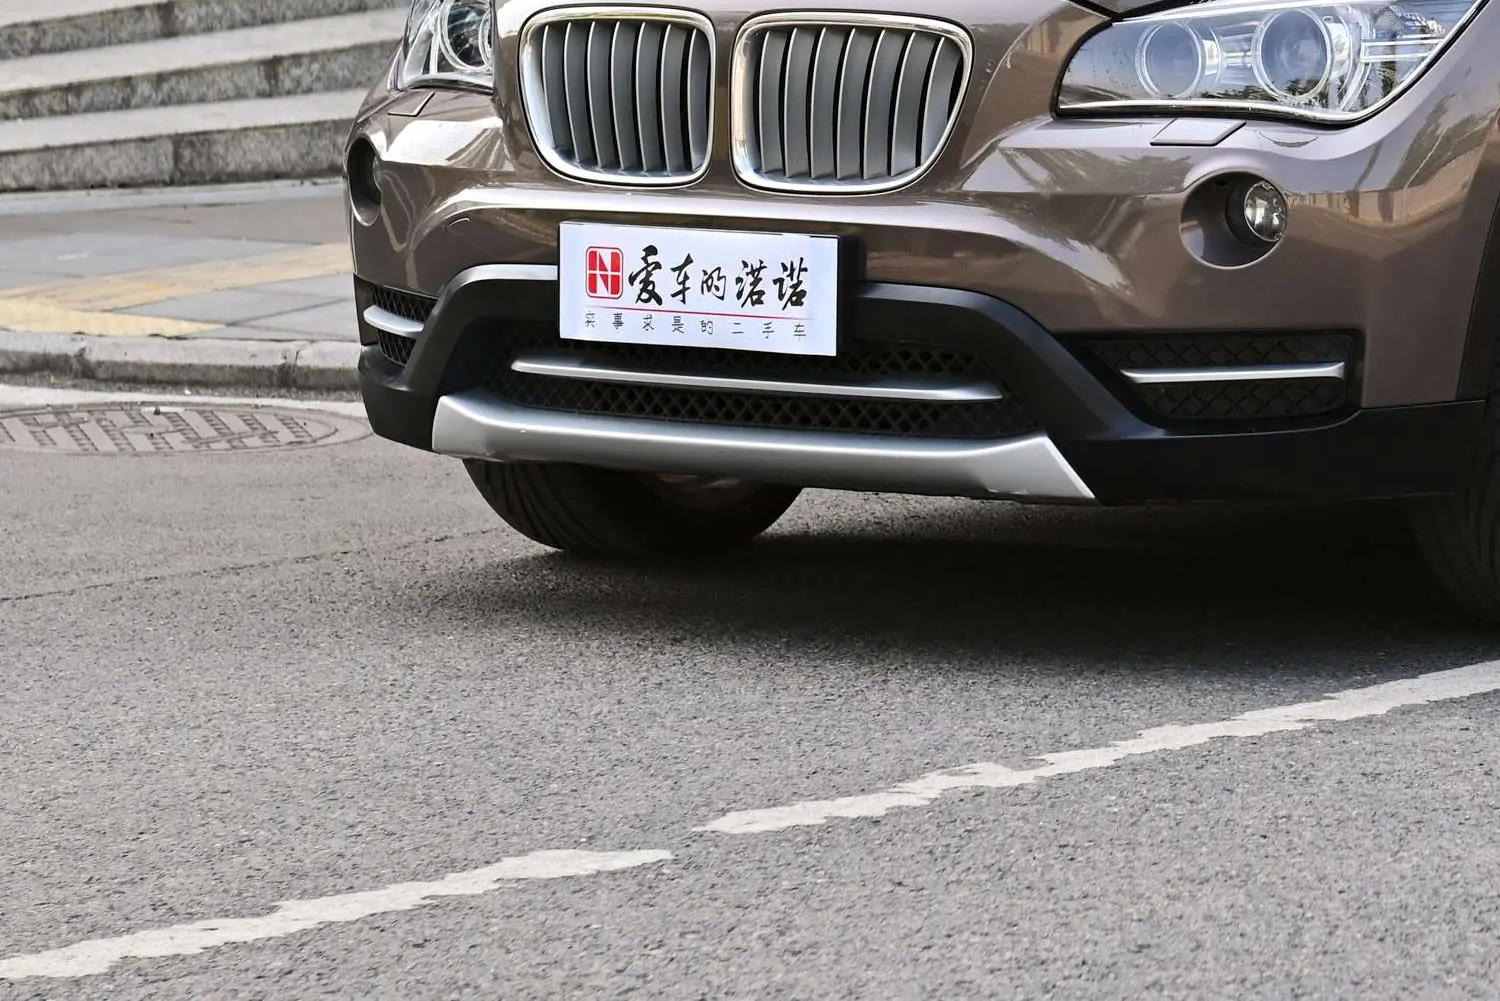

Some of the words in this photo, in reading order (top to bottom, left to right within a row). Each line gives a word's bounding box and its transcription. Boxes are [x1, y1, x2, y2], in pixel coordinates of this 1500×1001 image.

[584, 310, 806, 341] 实事求是的二手车
